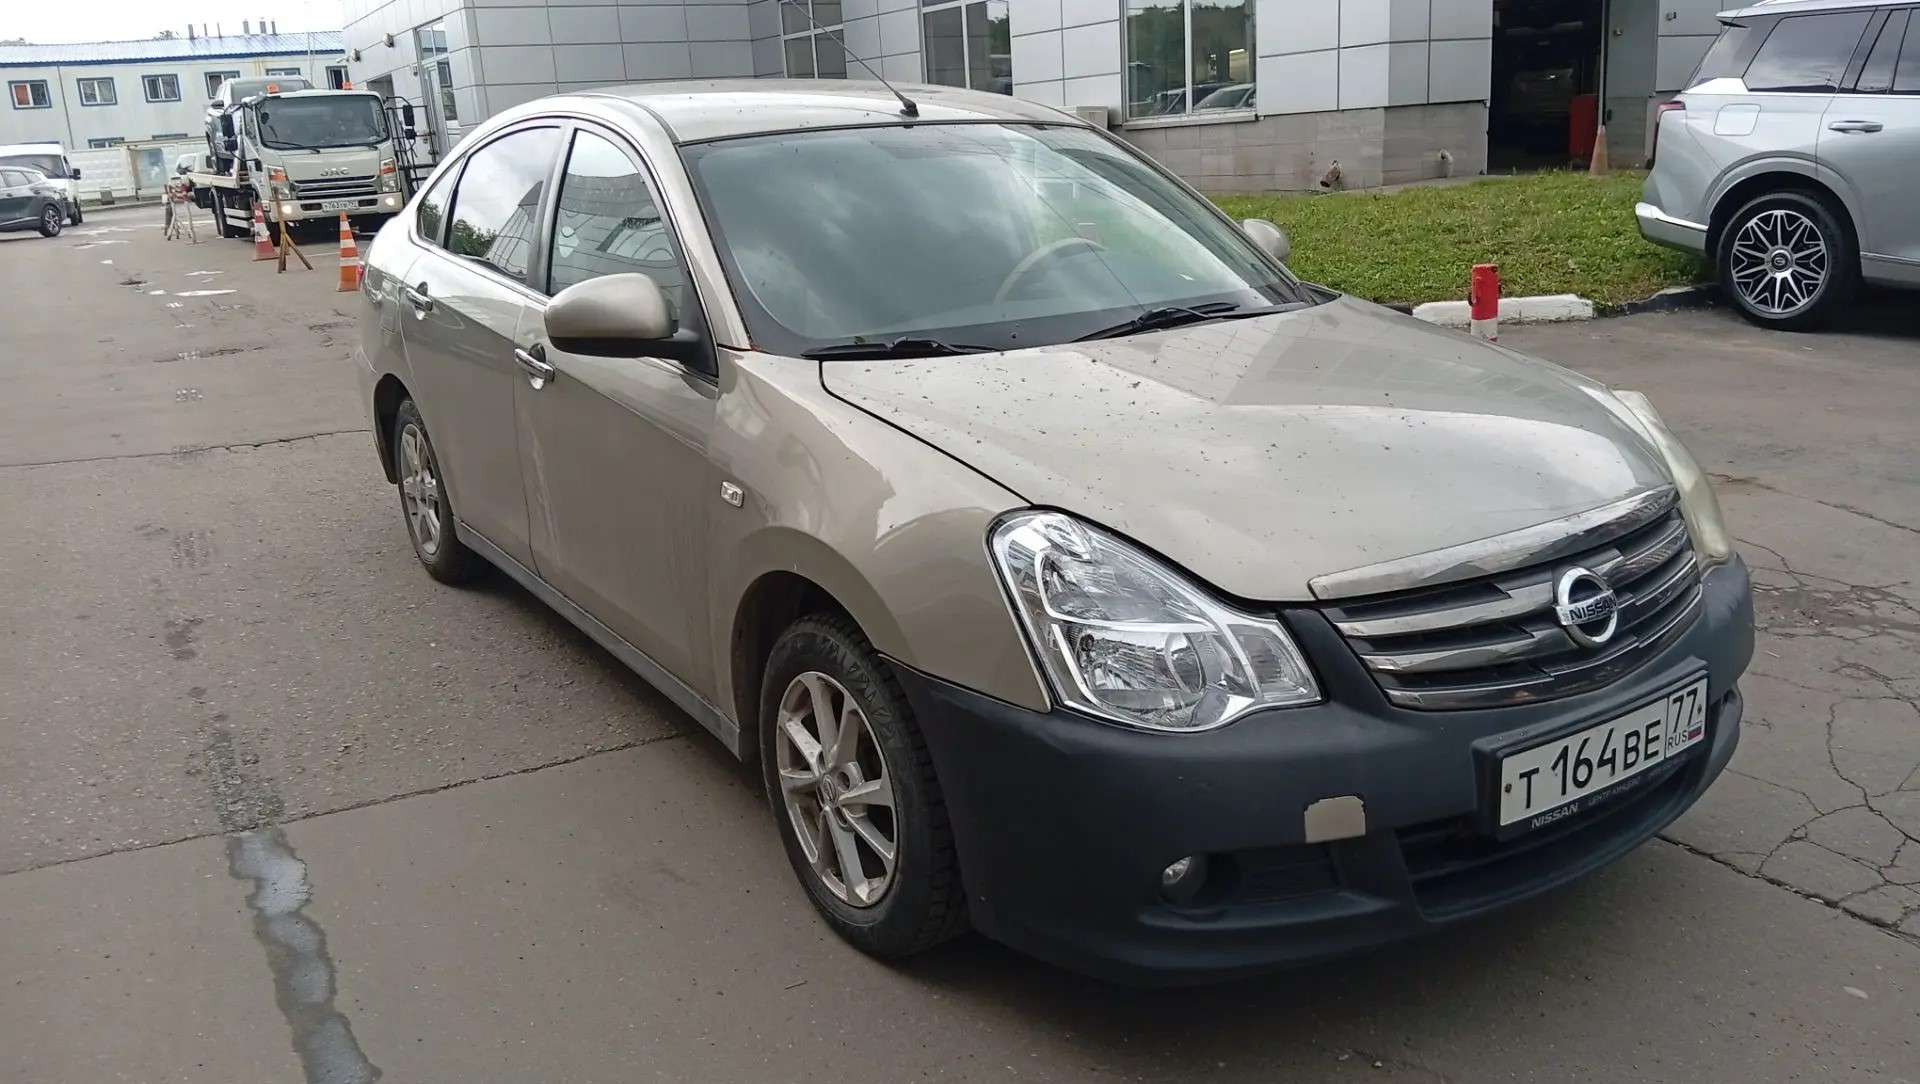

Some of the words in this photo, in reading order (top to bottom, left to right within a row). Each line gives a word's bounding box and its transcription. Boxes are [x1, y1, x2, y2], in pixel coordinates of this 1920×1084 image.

[320, 167, 350, 178] JAC
[1569, 596, 1616, 621] NISSAN
[1672, 687, 1698, 733] 77
[1667, 731, 1688, 749] RUS
[1531, 803, 1579, 829] NISSAN
